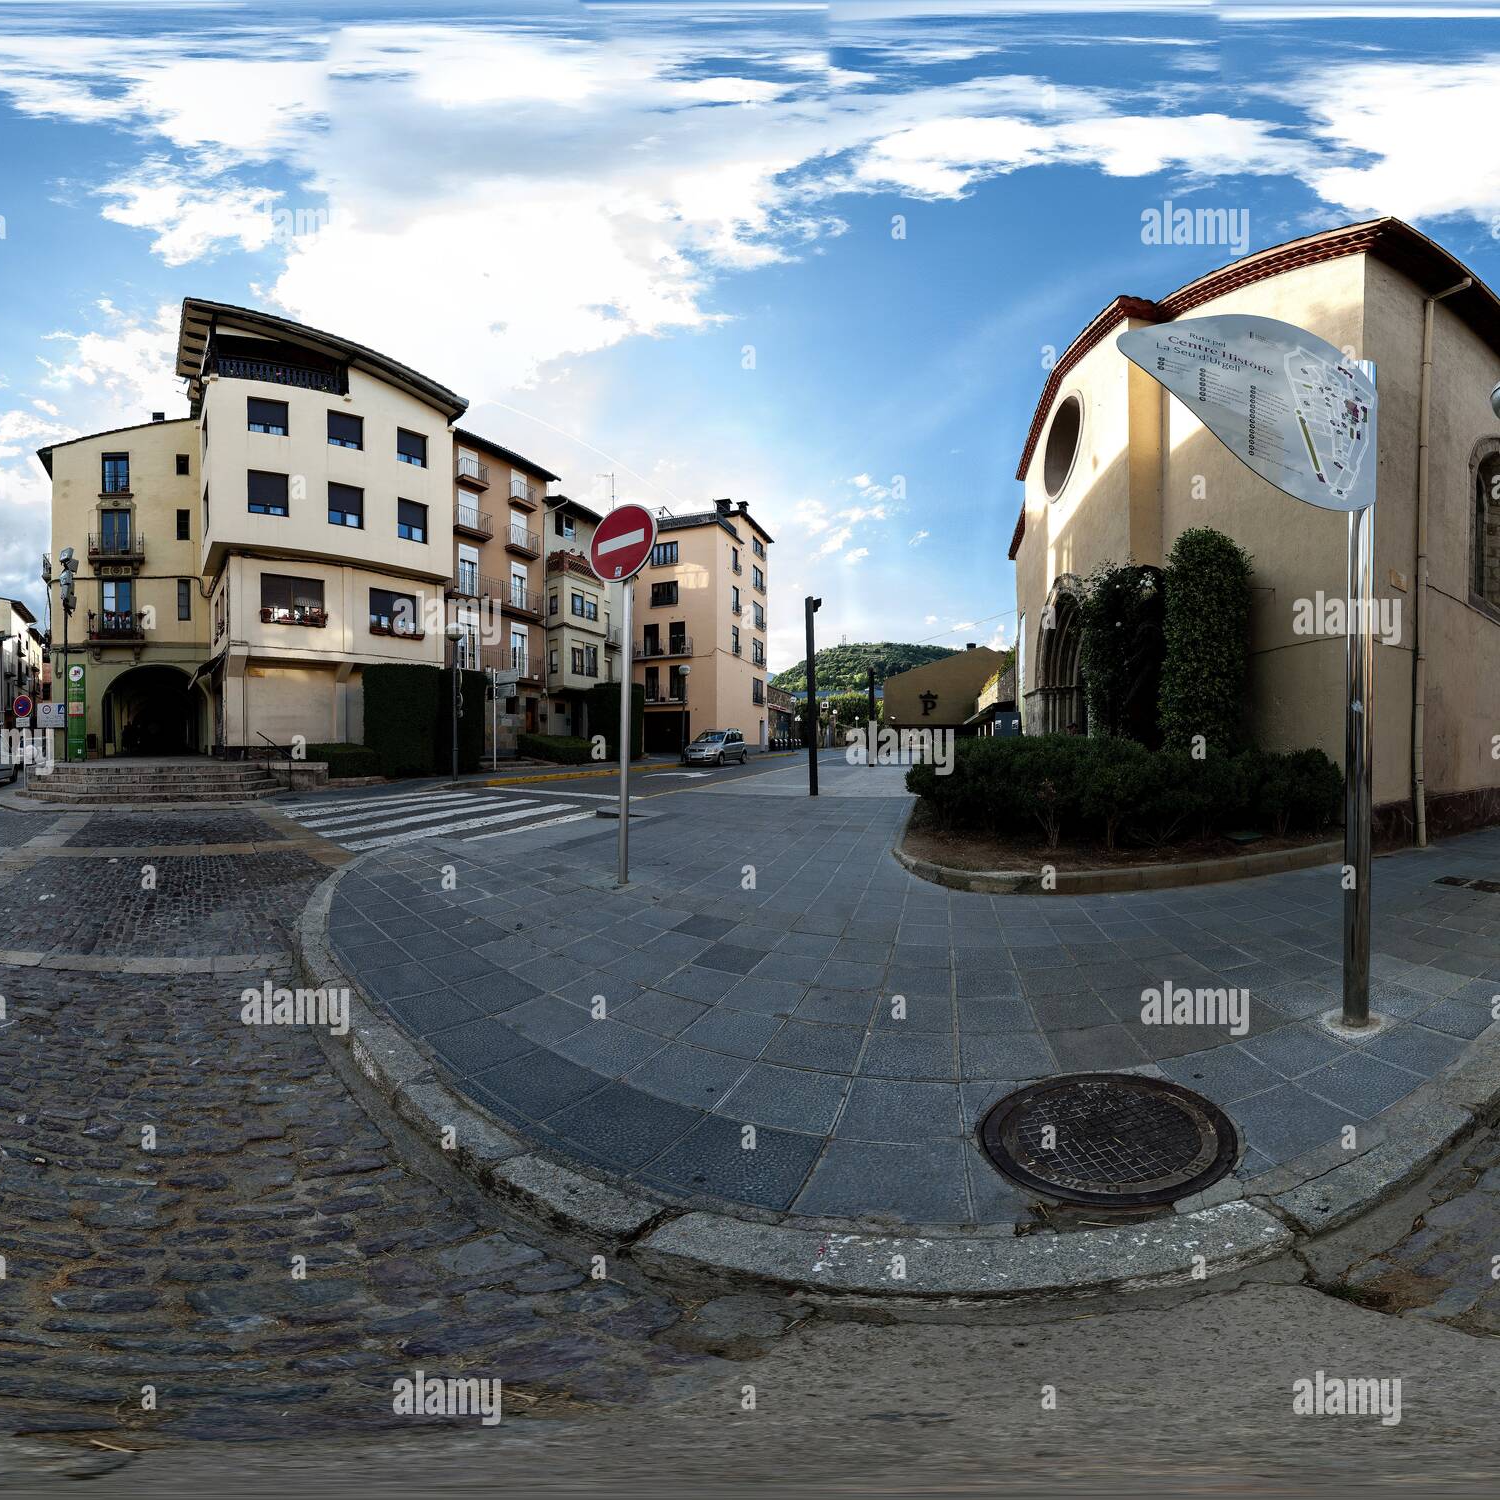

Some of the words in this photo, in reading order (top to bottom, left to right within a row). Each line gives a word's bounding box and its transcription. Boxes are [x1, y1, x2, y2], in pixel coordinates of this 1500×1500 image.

[1168, 335, 1218, 355] Centre
[1189, 332, 1210, 344] Ruta
[1156, 342, 1170, 352] La
[1173, 345, 1196, 358] Seu
[1198, 353, 1241, 373] d'Urgell
[922, 700, 937, 716] P
